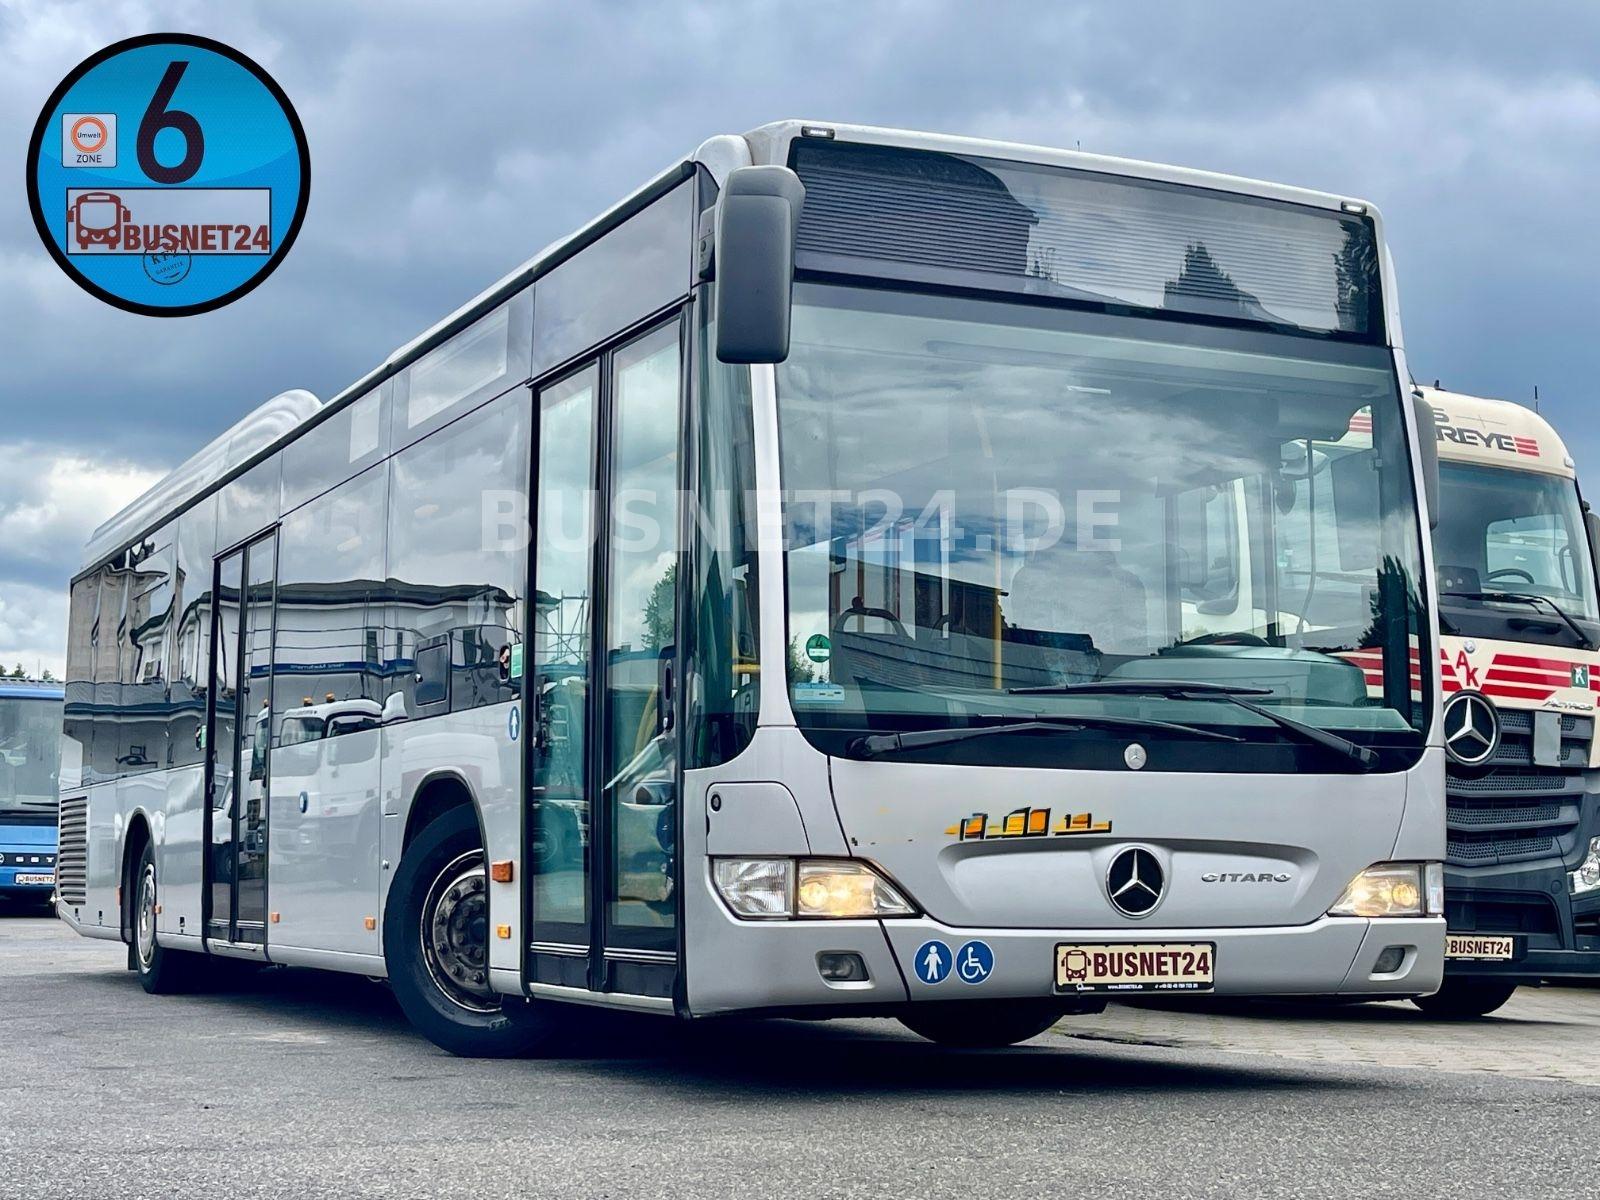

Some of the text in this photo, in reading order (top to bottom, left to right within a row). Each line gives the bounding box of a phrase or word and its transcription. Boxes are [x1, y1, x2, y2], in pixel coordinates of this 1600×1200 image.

[1436, 425, 1517, 453] REYE
[1201, 872, 1292, 883] CITARO
[1450, 940, 1511, 955] BUSNET24
[1093, 951, 1210, 977] BUSNET24
